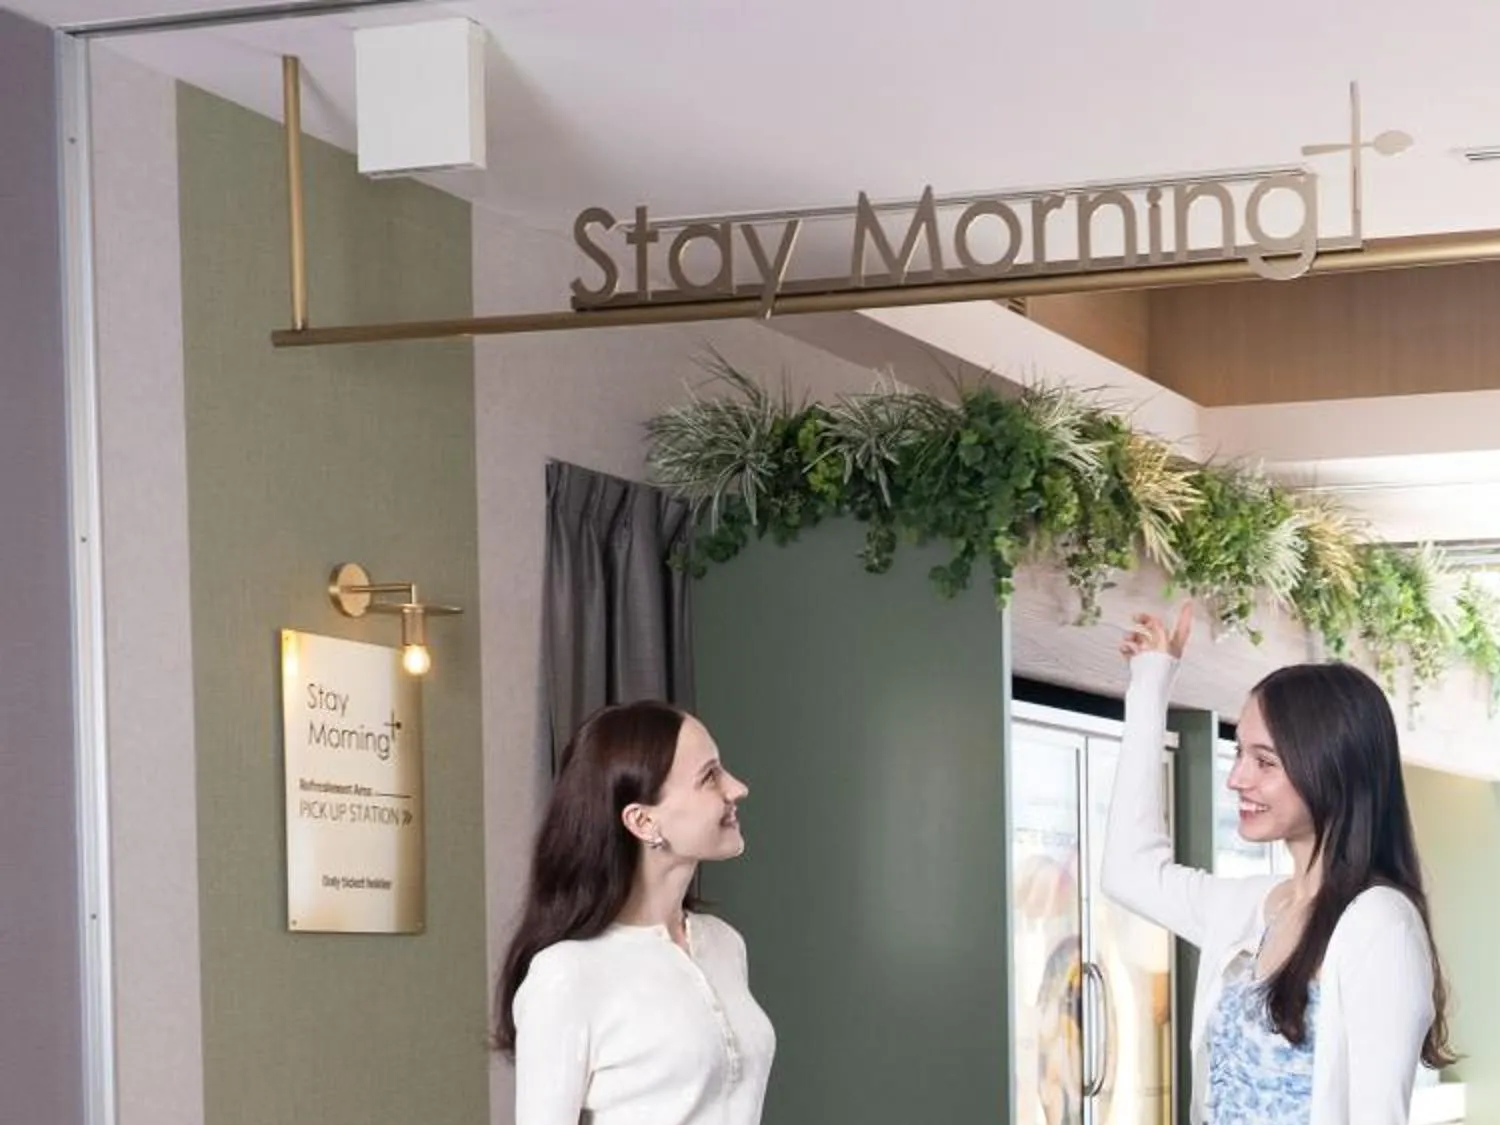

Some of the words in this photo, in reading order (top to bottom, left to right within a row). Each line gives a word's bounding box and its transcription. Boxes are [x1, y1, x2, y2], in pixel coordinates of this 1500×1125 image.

[570, 205, 800, 319] Stay
[851, 170, 1319, 282] Morning
[307, 683, 349, 716] Stay
[308, 722, 391, 761] Morning
[299, 799, 327, 819] PICK
[329, 802, 347, 822] UP
[350, 803, 400, 826] STATION
